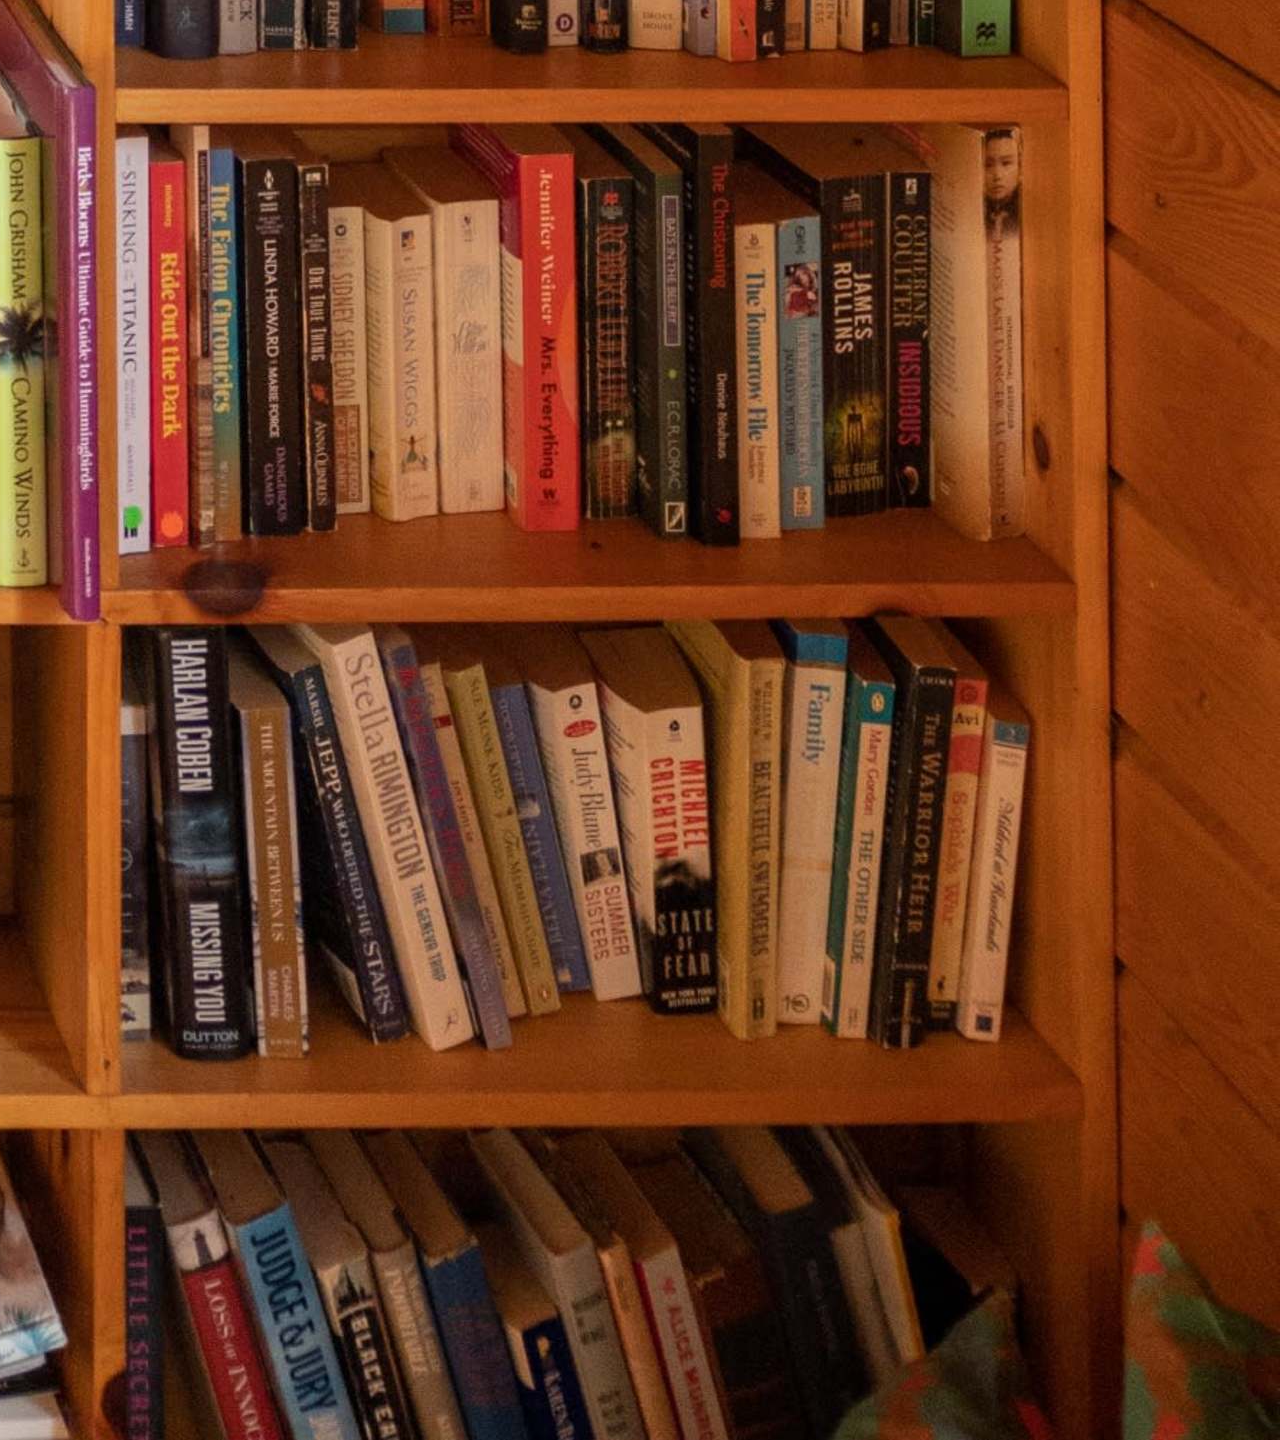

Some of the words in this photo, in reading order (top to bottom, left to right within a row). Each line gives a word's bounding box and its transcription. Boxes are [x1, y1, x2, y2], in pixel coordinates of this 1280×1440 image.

[833, 261, 854, 355] ROLLINS
[853, 271, 874, 340] JAMES
[11, 378, 32, 462] CAMINO
[897, 341, 922, 448] INSIDIOUS
[13, 468, 34, 540] WINDS
[171, 639, 212, 729] HARLAN
[175, 730, 214, 793] COBEN
[649, 757, 678, 859] CRICHTON
[679, 759, 707, 850] MICHAEL
[189, 902, 222, 975] MISSING
[656, 909, 715, 936] STATE
[195, 978, 225, 1023] YOU
[664, 953, 711, 979] FEAR
[252, 1228, 309, 1323] JUDGE
[280, 1320, 315, 1347] &
[284, 1345, 337, 1413] JURY
